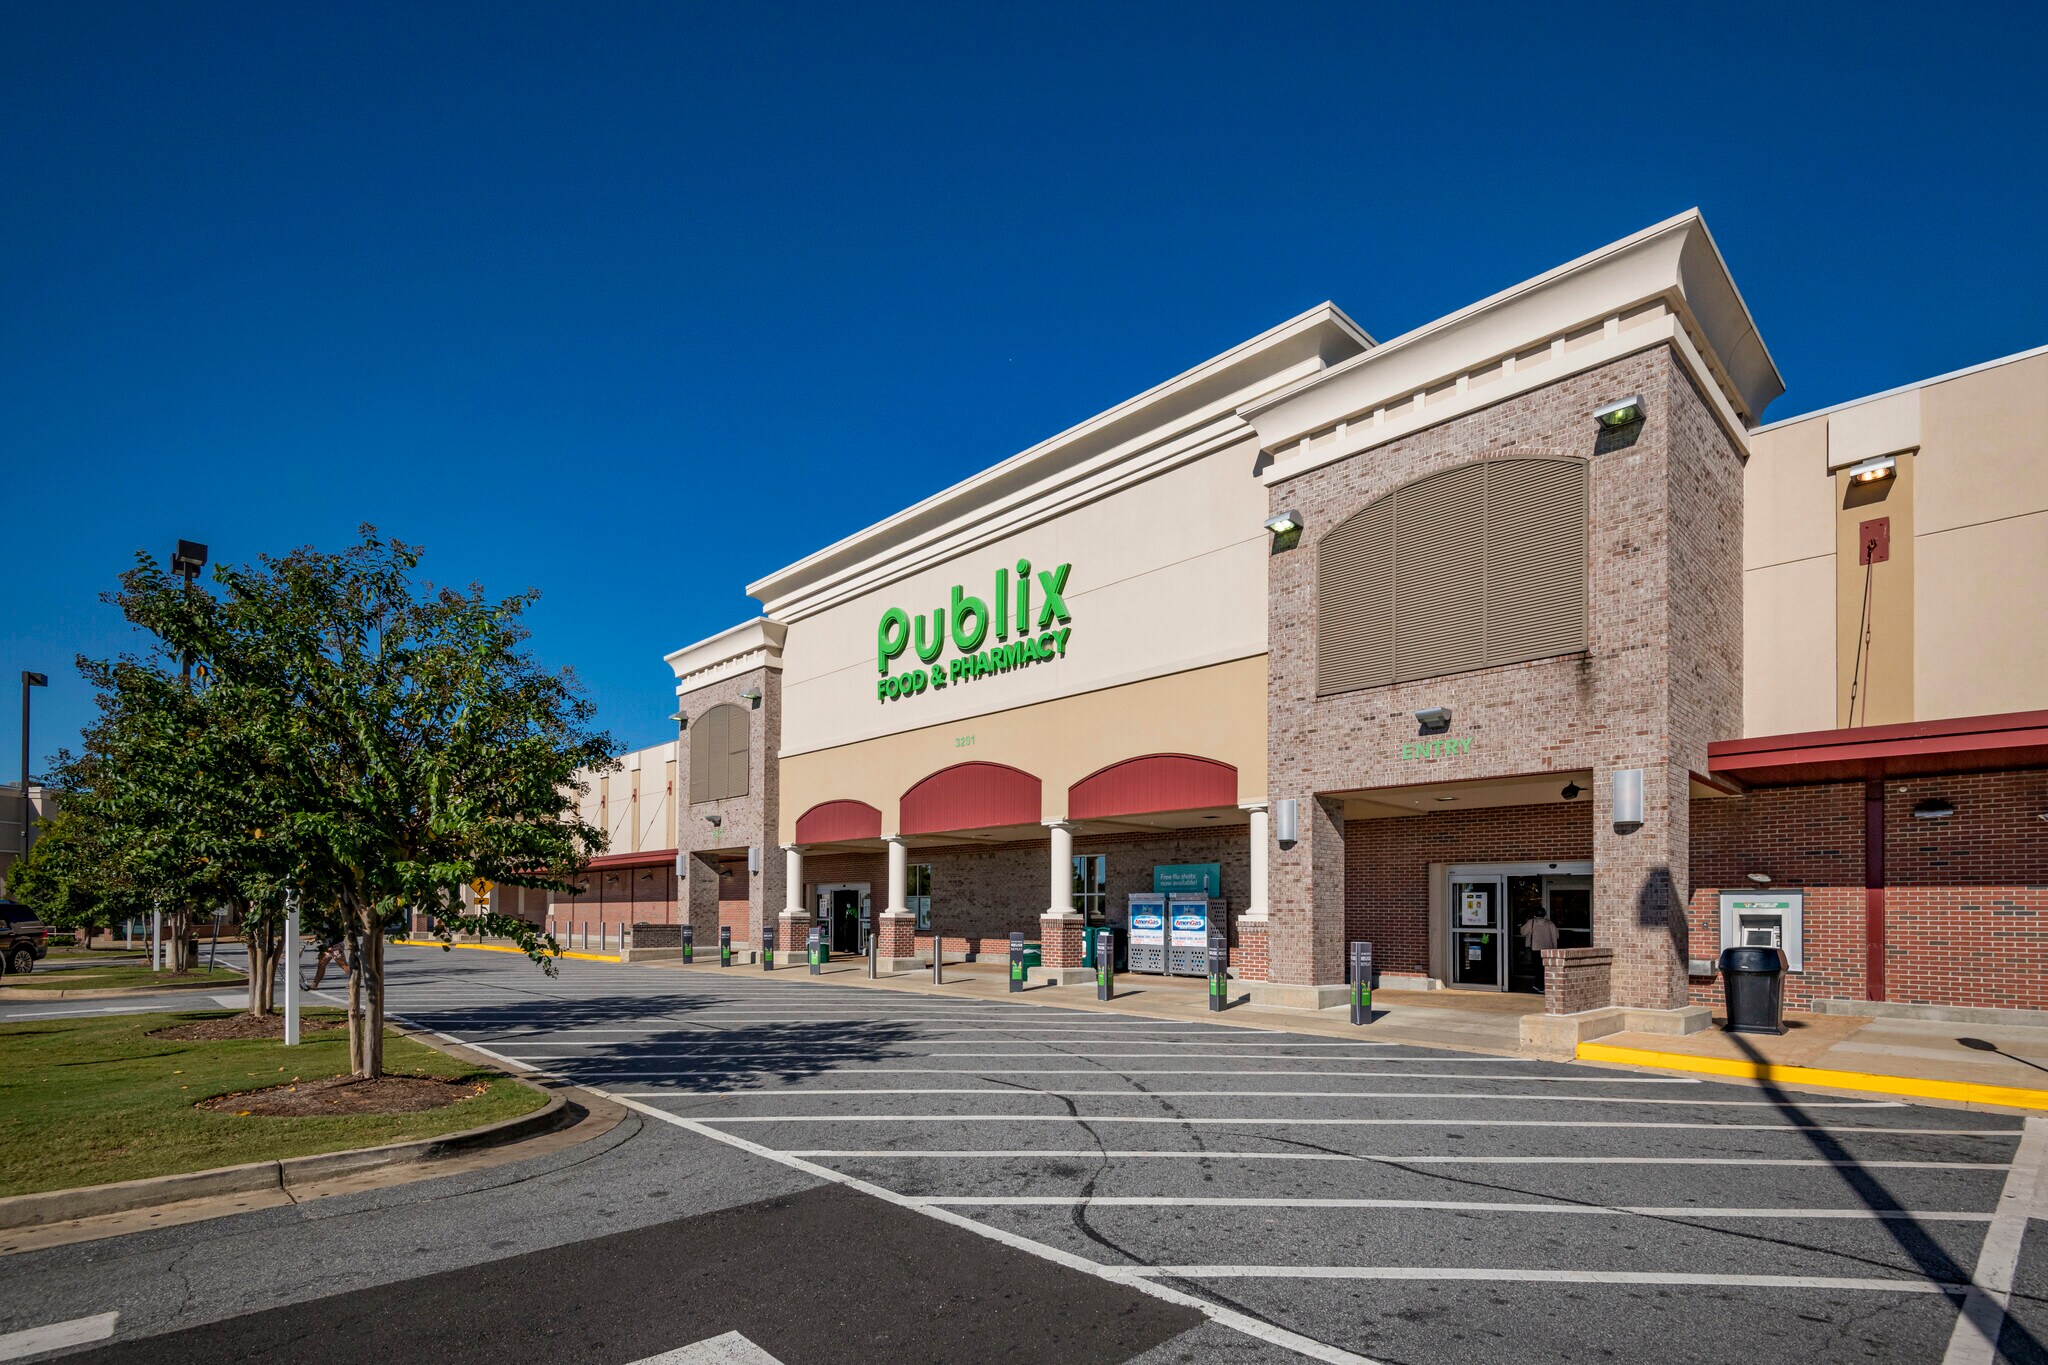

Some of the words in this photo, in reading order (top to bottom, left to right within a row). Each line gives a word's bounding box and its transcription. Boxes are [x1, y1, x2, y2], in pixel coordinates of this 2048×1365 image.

[878, 669, 928, 701] FOOD
[930, 664, 946, 686] &
[950, 627, 1072, 681] PHARMACY
[955, 735, 975, 748] 3201
[1402, 736, 1474, 760] ENTRY
